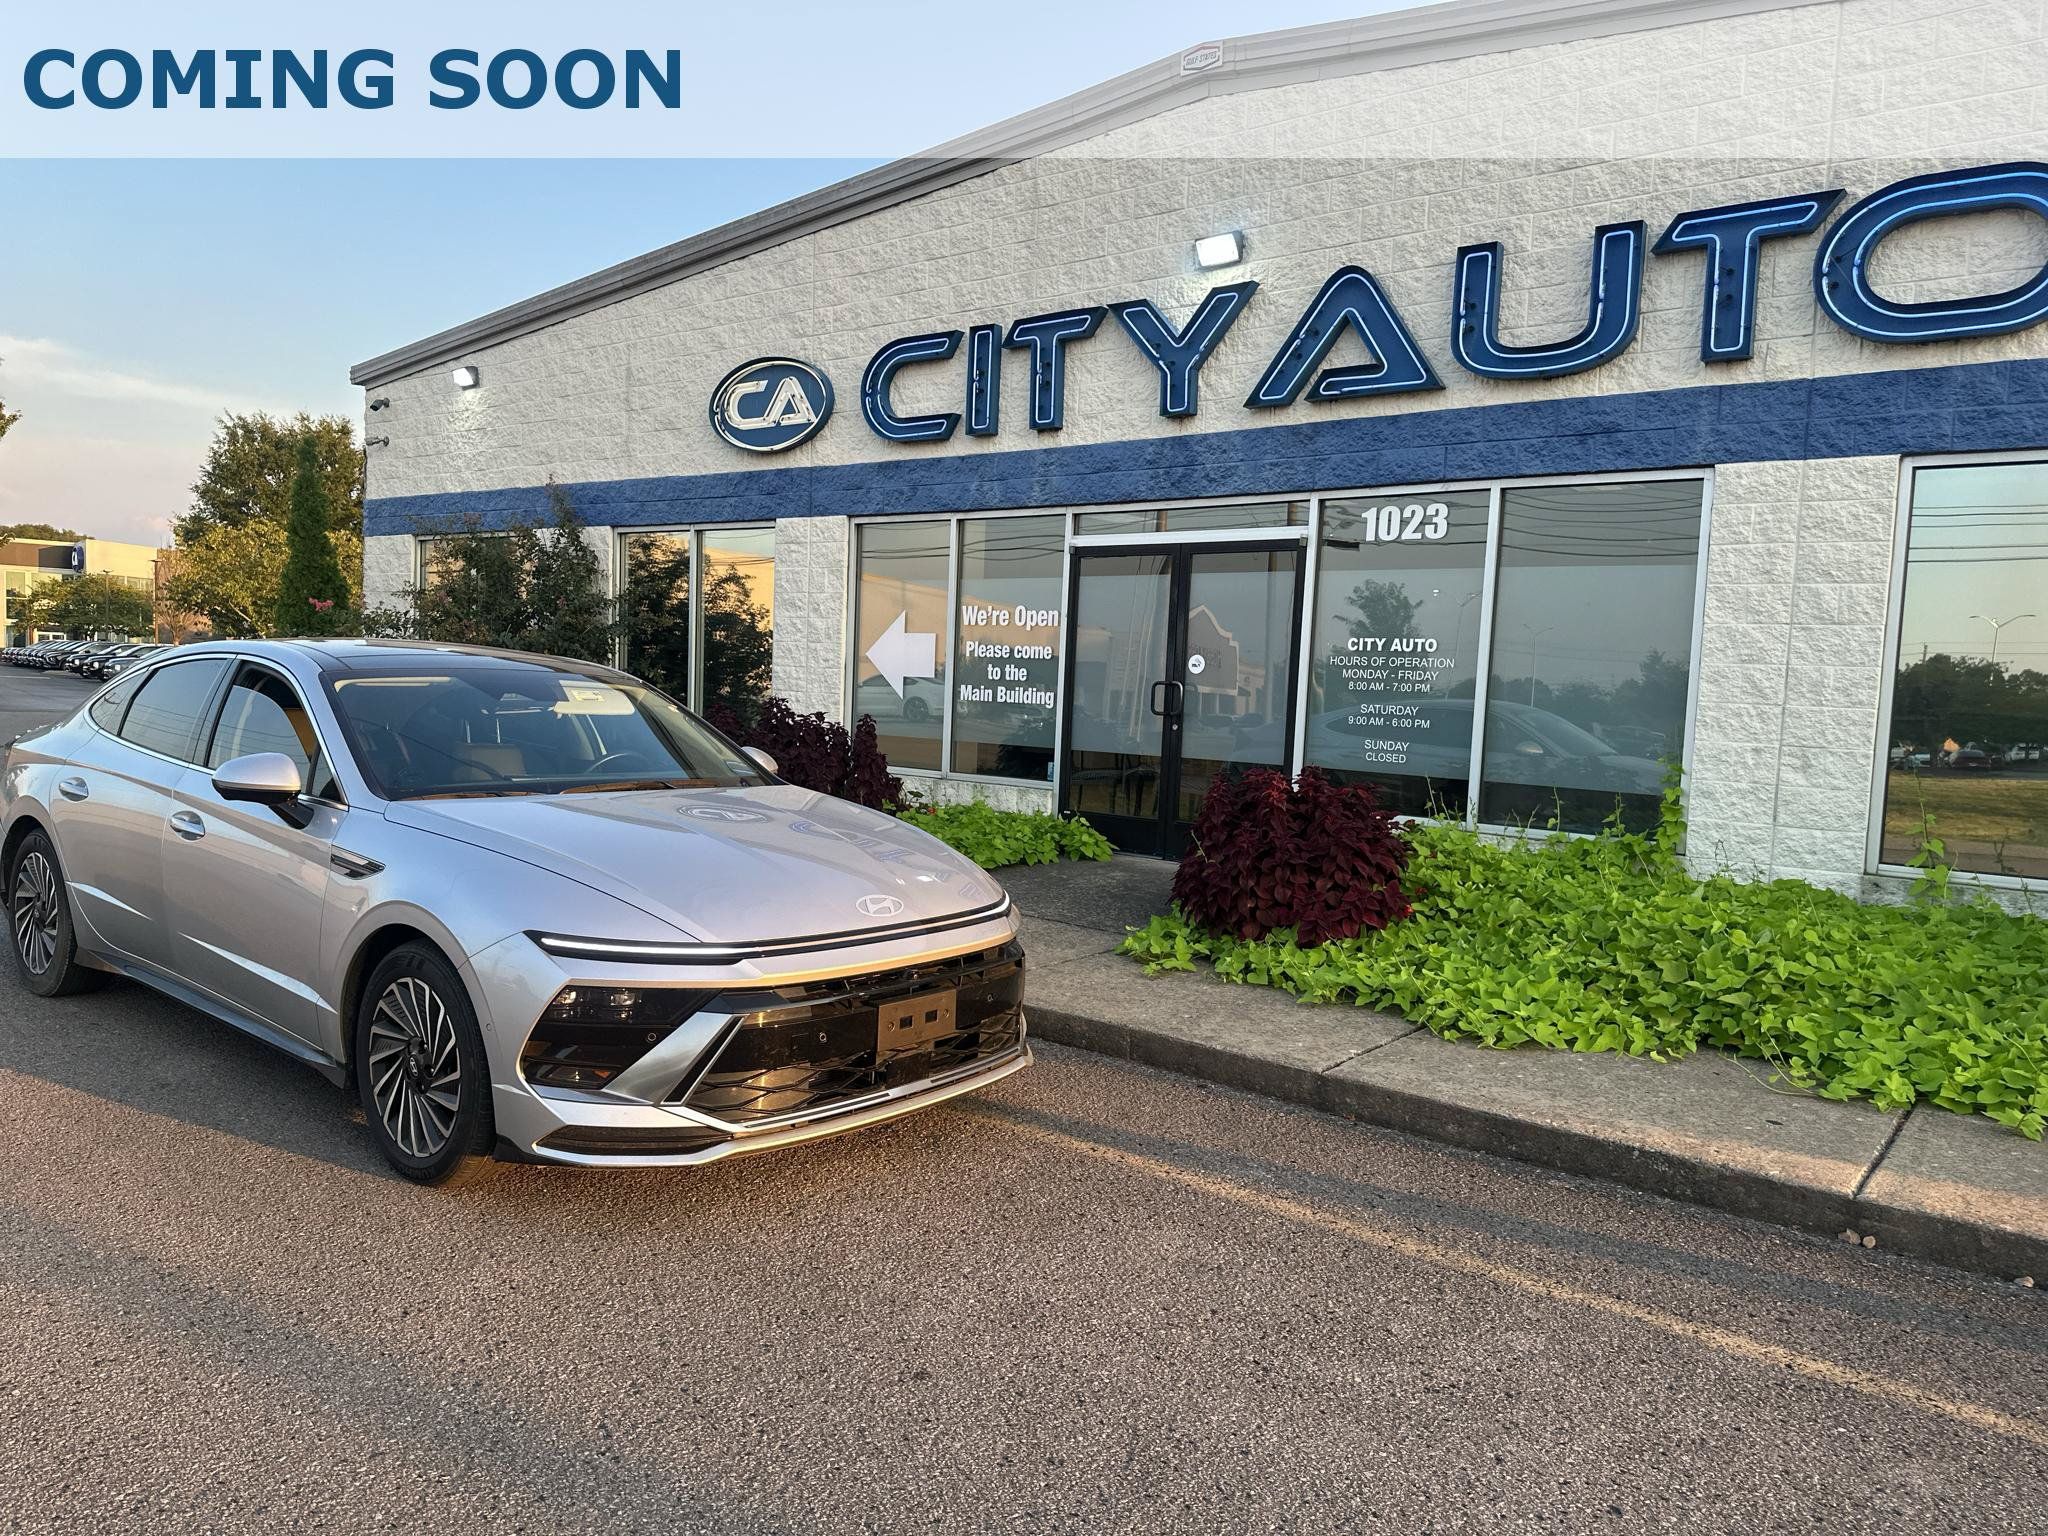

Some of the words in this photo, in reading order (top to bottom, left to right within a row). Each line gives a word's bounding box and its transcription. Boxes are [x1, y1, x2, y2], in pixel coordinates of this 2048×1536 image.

[861, 280, 1259, 443] CITY
[1243, 160, 2048, 409] AUTO
[724, 376, 816, 431] CA
[1361, 503, 1449, 542] 1023
[962, 605, 1009, 626] We're
[1015, 605, 1059, 631] Open
[965, 641, 1010, 658] Please
[1014, 645, 1052, 659] come
[1347, 638, 1386, 652] CITY
[1390, 638, 1438, 652] AUTO
[1329, 656, 1368, 666] HOURS
[1370, 657, 1386, 667] OF
[1389, 657, 1455, 669] OPERATION
[987, 664, 1001, 680] to
[1005, 664, 1027, 681] the
[1342, 669, 1389, 680] MONDAY
[1398, 670, 1439, 681] FRIDAY
[1348, 682, 1368, 691] 8:00
[1369, 682, 1384, 691] AM
[1393, 683, 1412, 692] 7:00
[1414, 684, 1430, 693] PM
[960, 684, 993, 702] Main
[997, 685, 1055, 709] Building
[1360, 704, 1419, 716] SATURDAY
[1348, 716, 1367, 725] 9:00
[1369, 717, 1384, 726] AM
[1392, 718, 1412, 728] 6:00
[1414, 719, 1430, 729] PM
[1364, 740, 1410, 752] SUNDAY
[1365, 752, 1406, 763] CLOSED
